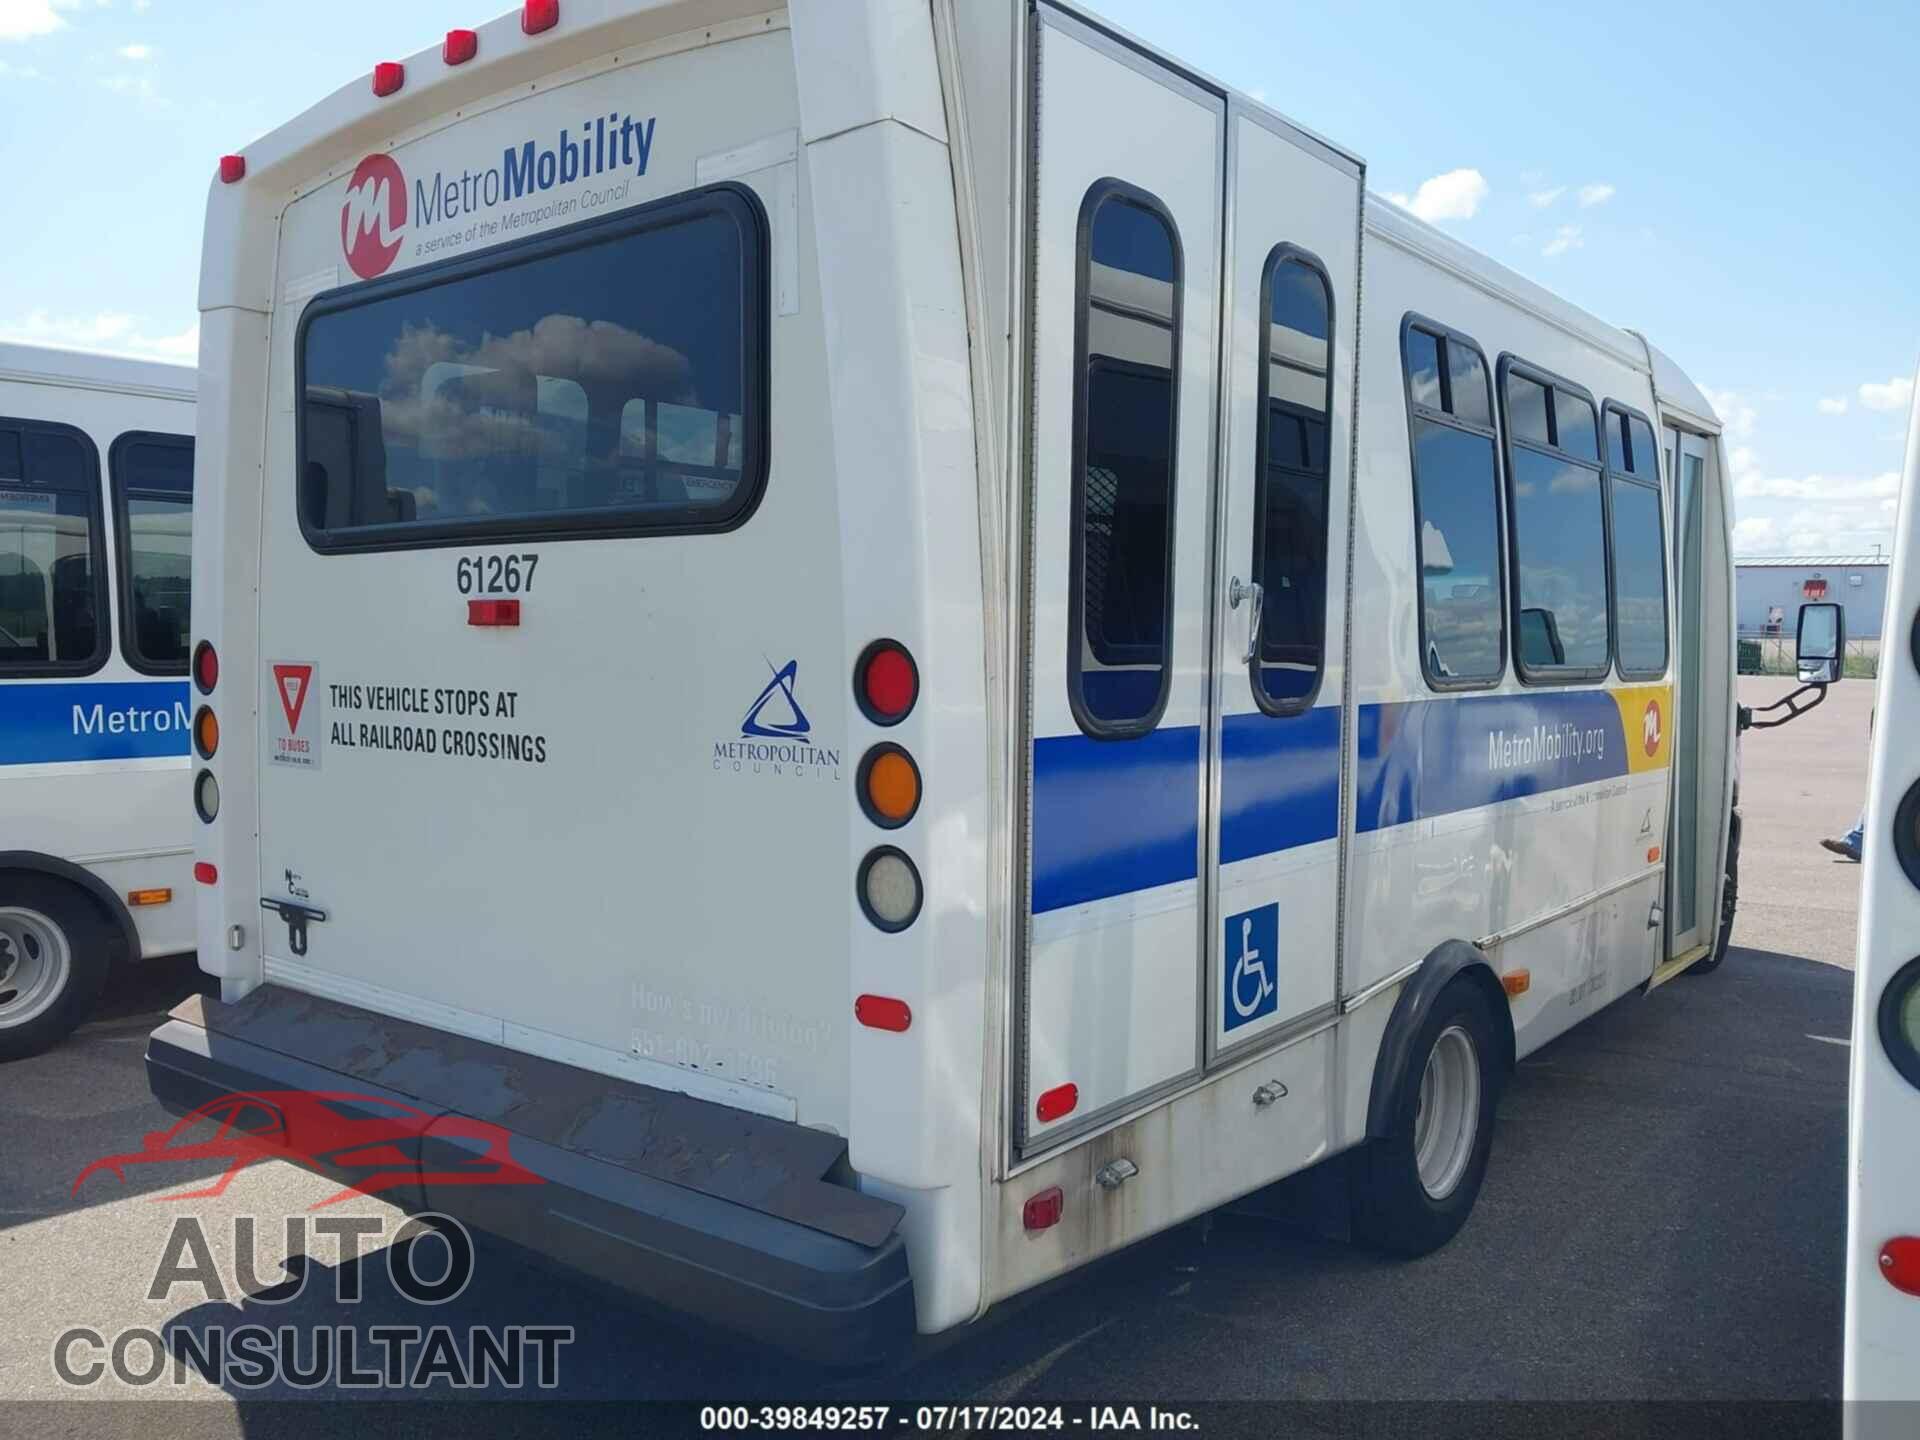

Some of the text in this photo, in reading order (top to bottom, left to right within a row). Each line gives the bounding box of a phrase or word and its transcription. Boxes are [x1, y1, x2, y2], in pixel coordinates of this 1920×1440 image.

[416, 112, 656, 228] MetroMobility
[415, 179, 630, 257] a service of the Metropolitan Council
[456, 553, 539, 594] 61267
[329, 684, 518, 718] THIS VEHICLE STOPS AT
[330, 721, 546, 763] ALL RAILROAD CROSSINGS
[713, 742, 840, 765] METROPOLITAN
[1488, 723, 1605, 771] MetroMobility.org
[712, 759, 841, 780] COUNCIL
